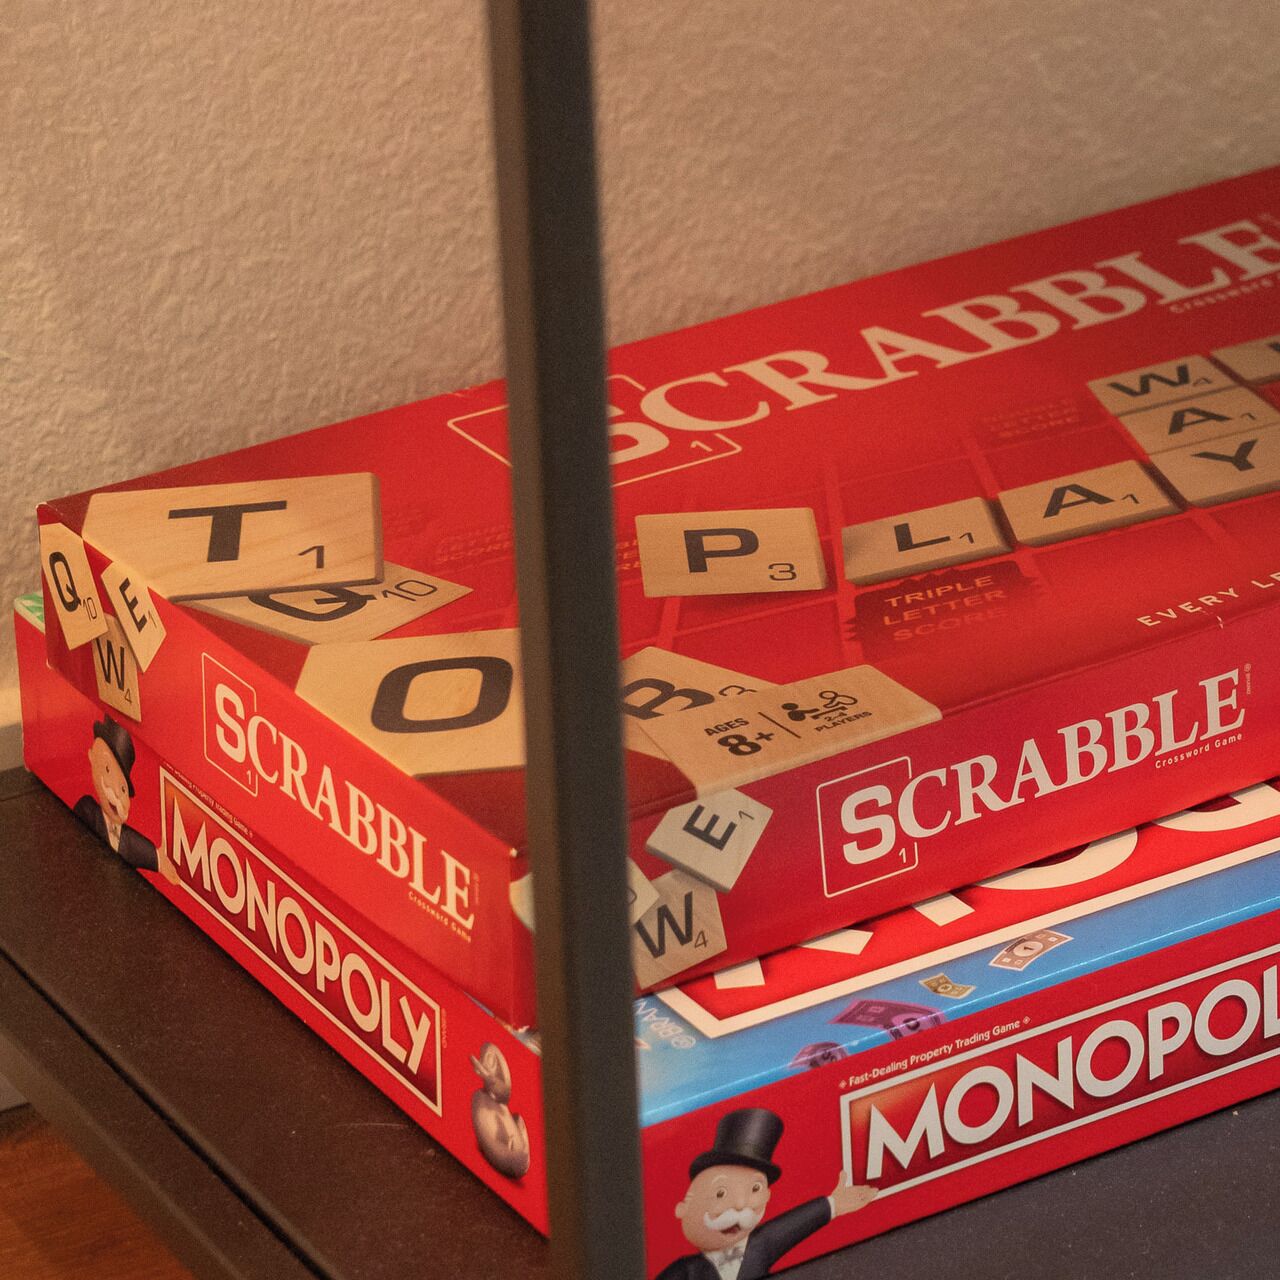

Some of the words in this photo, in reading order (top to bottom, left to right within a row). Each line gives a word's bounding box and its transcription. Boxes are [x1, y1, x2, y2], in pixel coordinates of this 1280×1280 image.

[882, 588, 1007, 626] LETTER
[883, 574, 994, 609] TRIPLE
[1137, 586, 1240, 627] EVERY
[703, 718, 750, 737] AGES
[814, 711, 873, 732] PLAYERS
[717, 730, 775, 757] 8+
[1155, 743, 1211, 769] Crossword
[1214, 733, 1243, 749] Game
[840, 667, 1246, 865] SCRABBLE
[215, 683, 475, 931] SCRABBLE
[172, 794, 431, 1076] MONOPOLY
[847, 1058, 908, 1089] Fast-Dealing
[910, 1042, 953, 1068] Property
[954, 1027, 992, 1051] Trading
[992, 1019, 1021, 1038] Game
